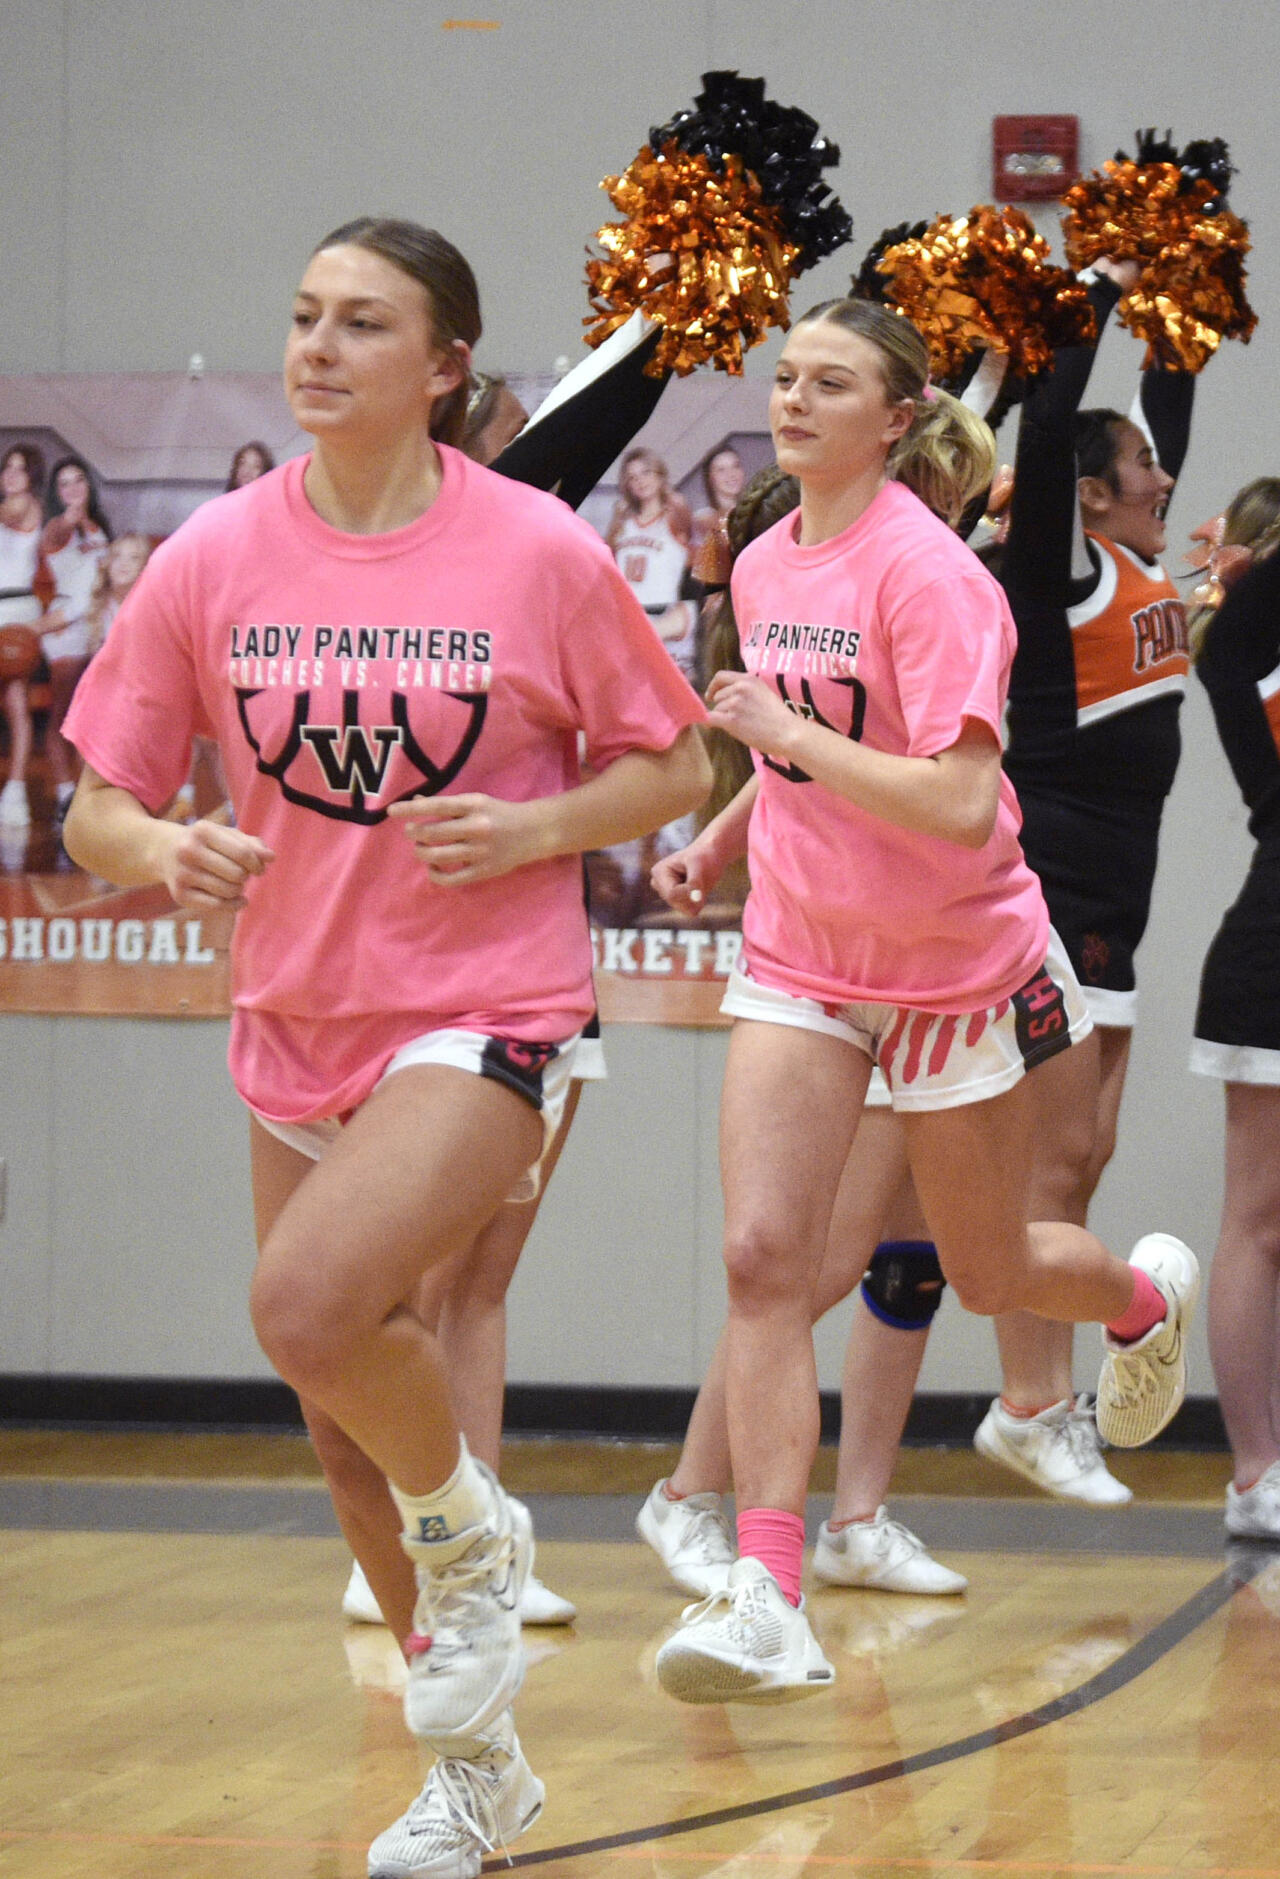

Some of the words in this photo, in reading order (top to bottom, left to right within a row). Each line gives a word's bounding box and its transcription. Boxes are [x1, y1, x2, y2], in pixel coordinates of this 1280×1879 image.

[230, 624, 303, 660] LADY
[312, 625, 493, 664] PANTHERS
[764, 620, 861, 658] PANTHERS
[228, 659, 326, 688] COACHES
[341, 661, 379, 688] VS.
[396, 662, 493, 692] CANCER
[299, 725, 405, 797] W
[0, 916, 215, 963] HOUGAL
